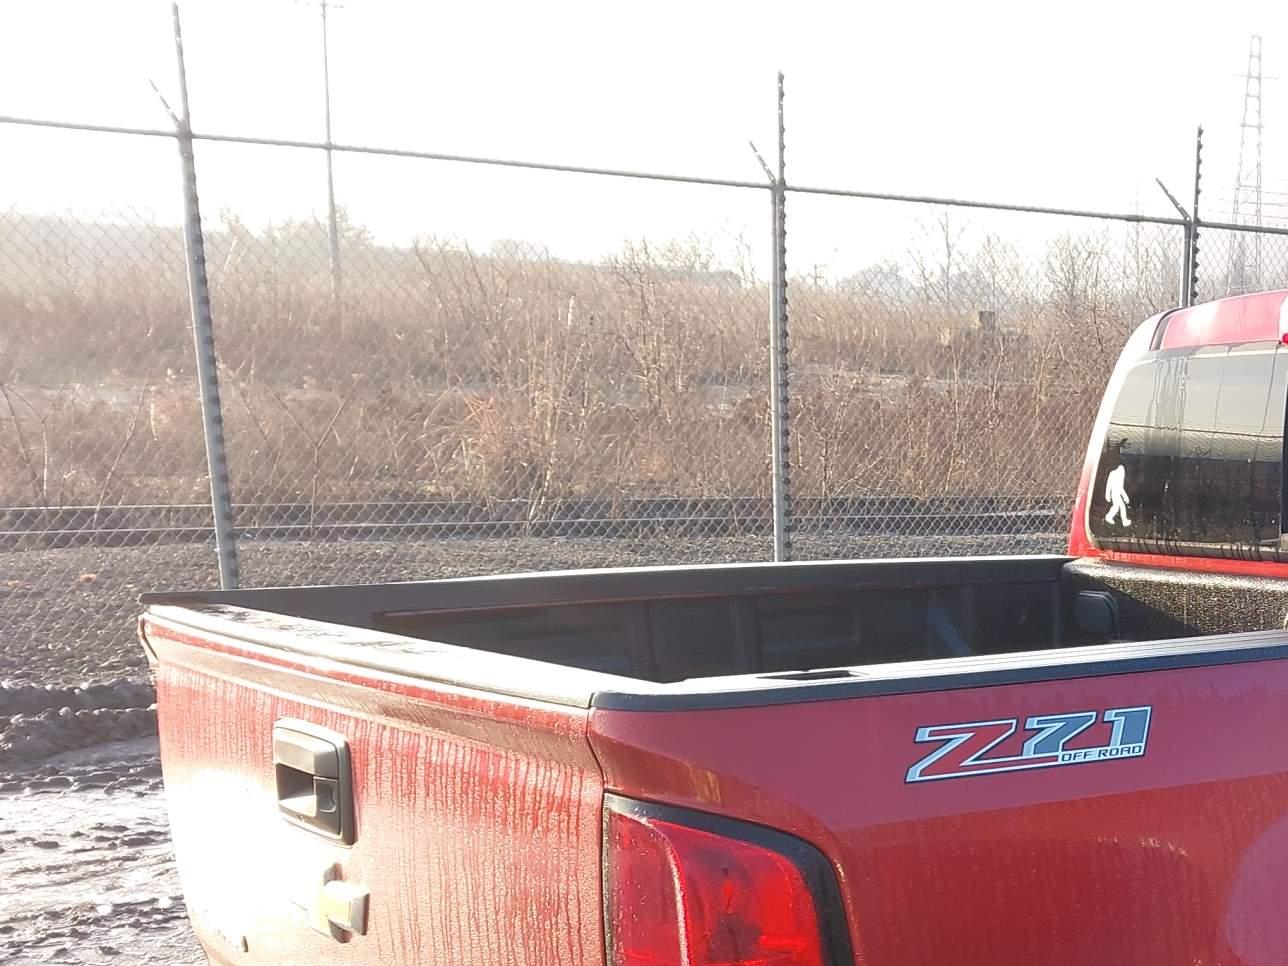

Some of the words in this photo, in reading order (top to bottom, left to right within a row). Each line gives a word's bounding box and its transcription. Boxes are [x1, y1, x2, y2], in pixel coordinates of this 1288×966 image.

[904, 705, 1153, 784] Z71
[1060, 750, 1097, 764] OFF
[1097, 744, 1143, 760] ROAD
